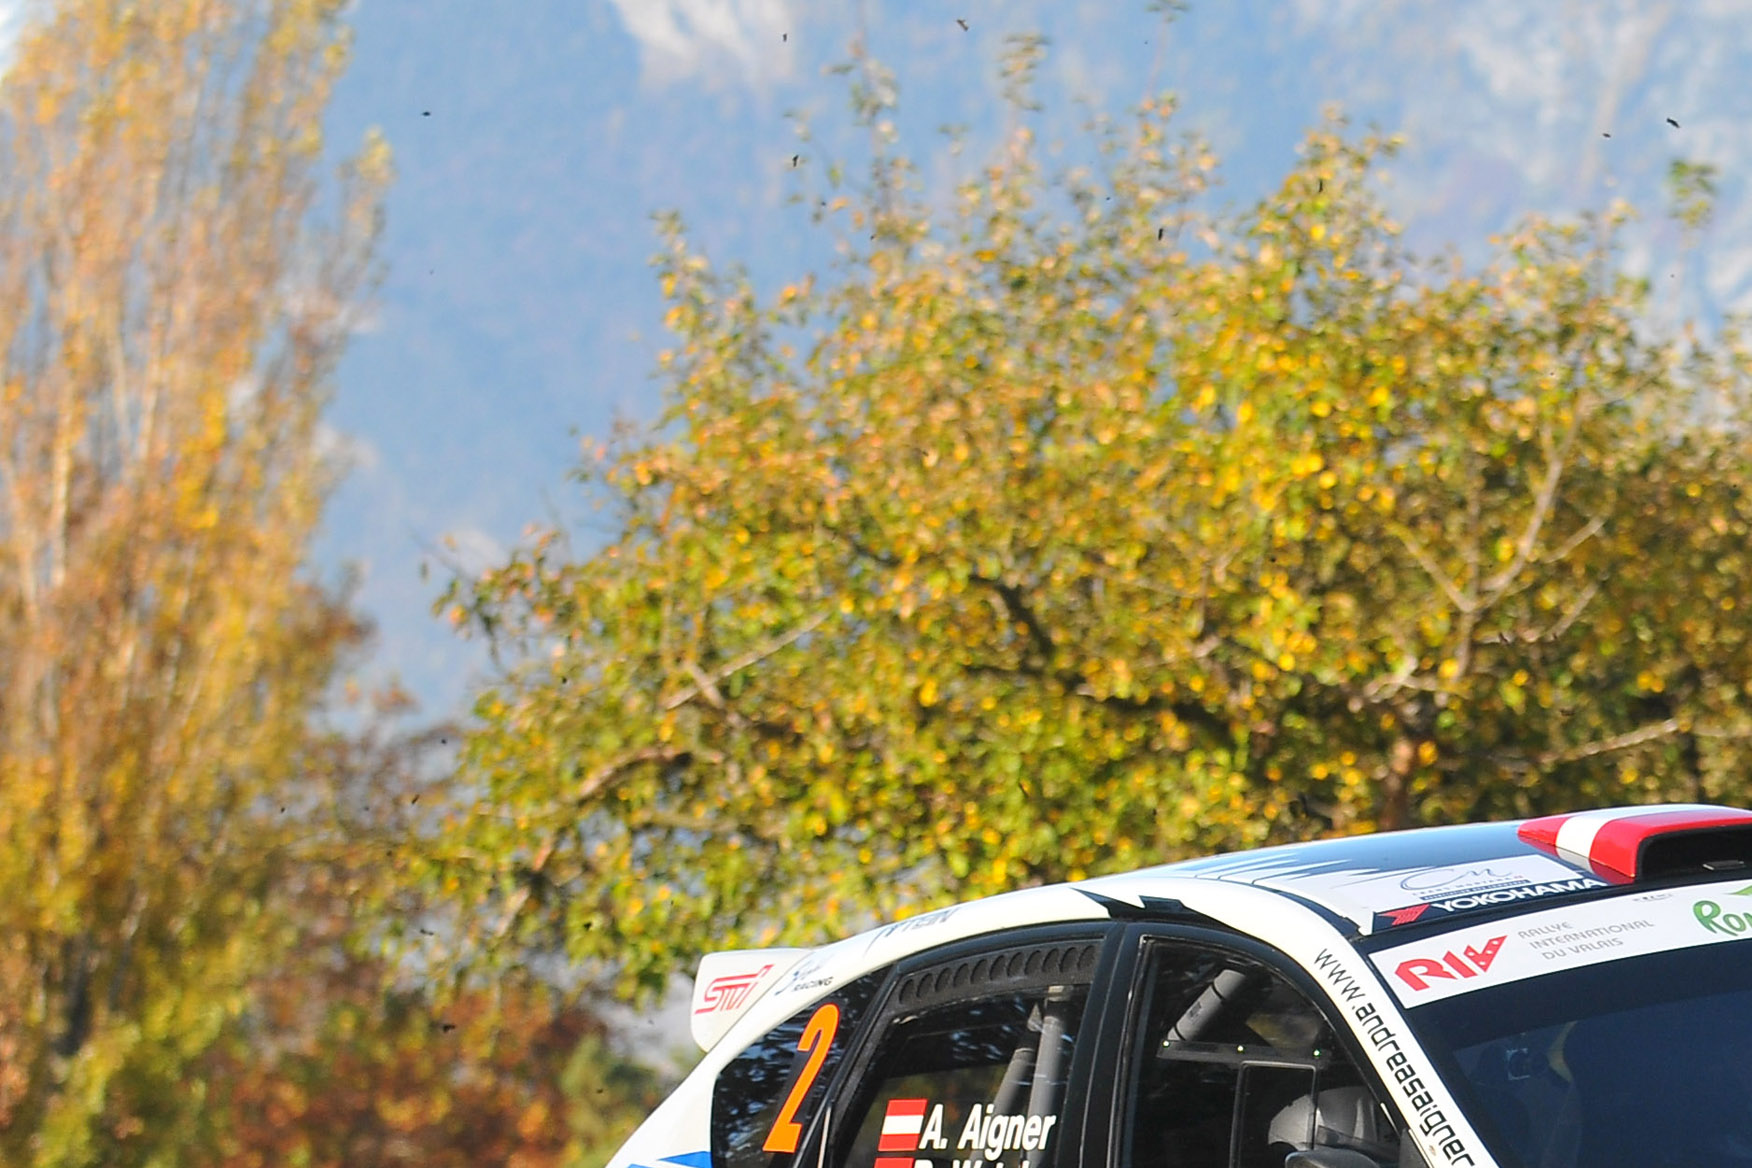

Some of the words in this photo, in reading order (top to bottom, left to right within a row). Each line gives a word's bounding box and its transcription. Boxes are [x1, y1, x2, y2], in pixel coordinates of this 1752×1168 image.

[1432, 878, 1608, 912] YOKOHAMA
[1518, 921, 1574, 940] RALLYE
[1530, 919, 1655, 949] INTERNATIONAL
[1542, 949, 1567, 960] DU
[1569, 937, 1624, 954] VALAIS
[762, 1003, 840, 1153] 2
[918, 1105, 949, 1151] A.
[957, 1103, 1056, 1160] Aigner
